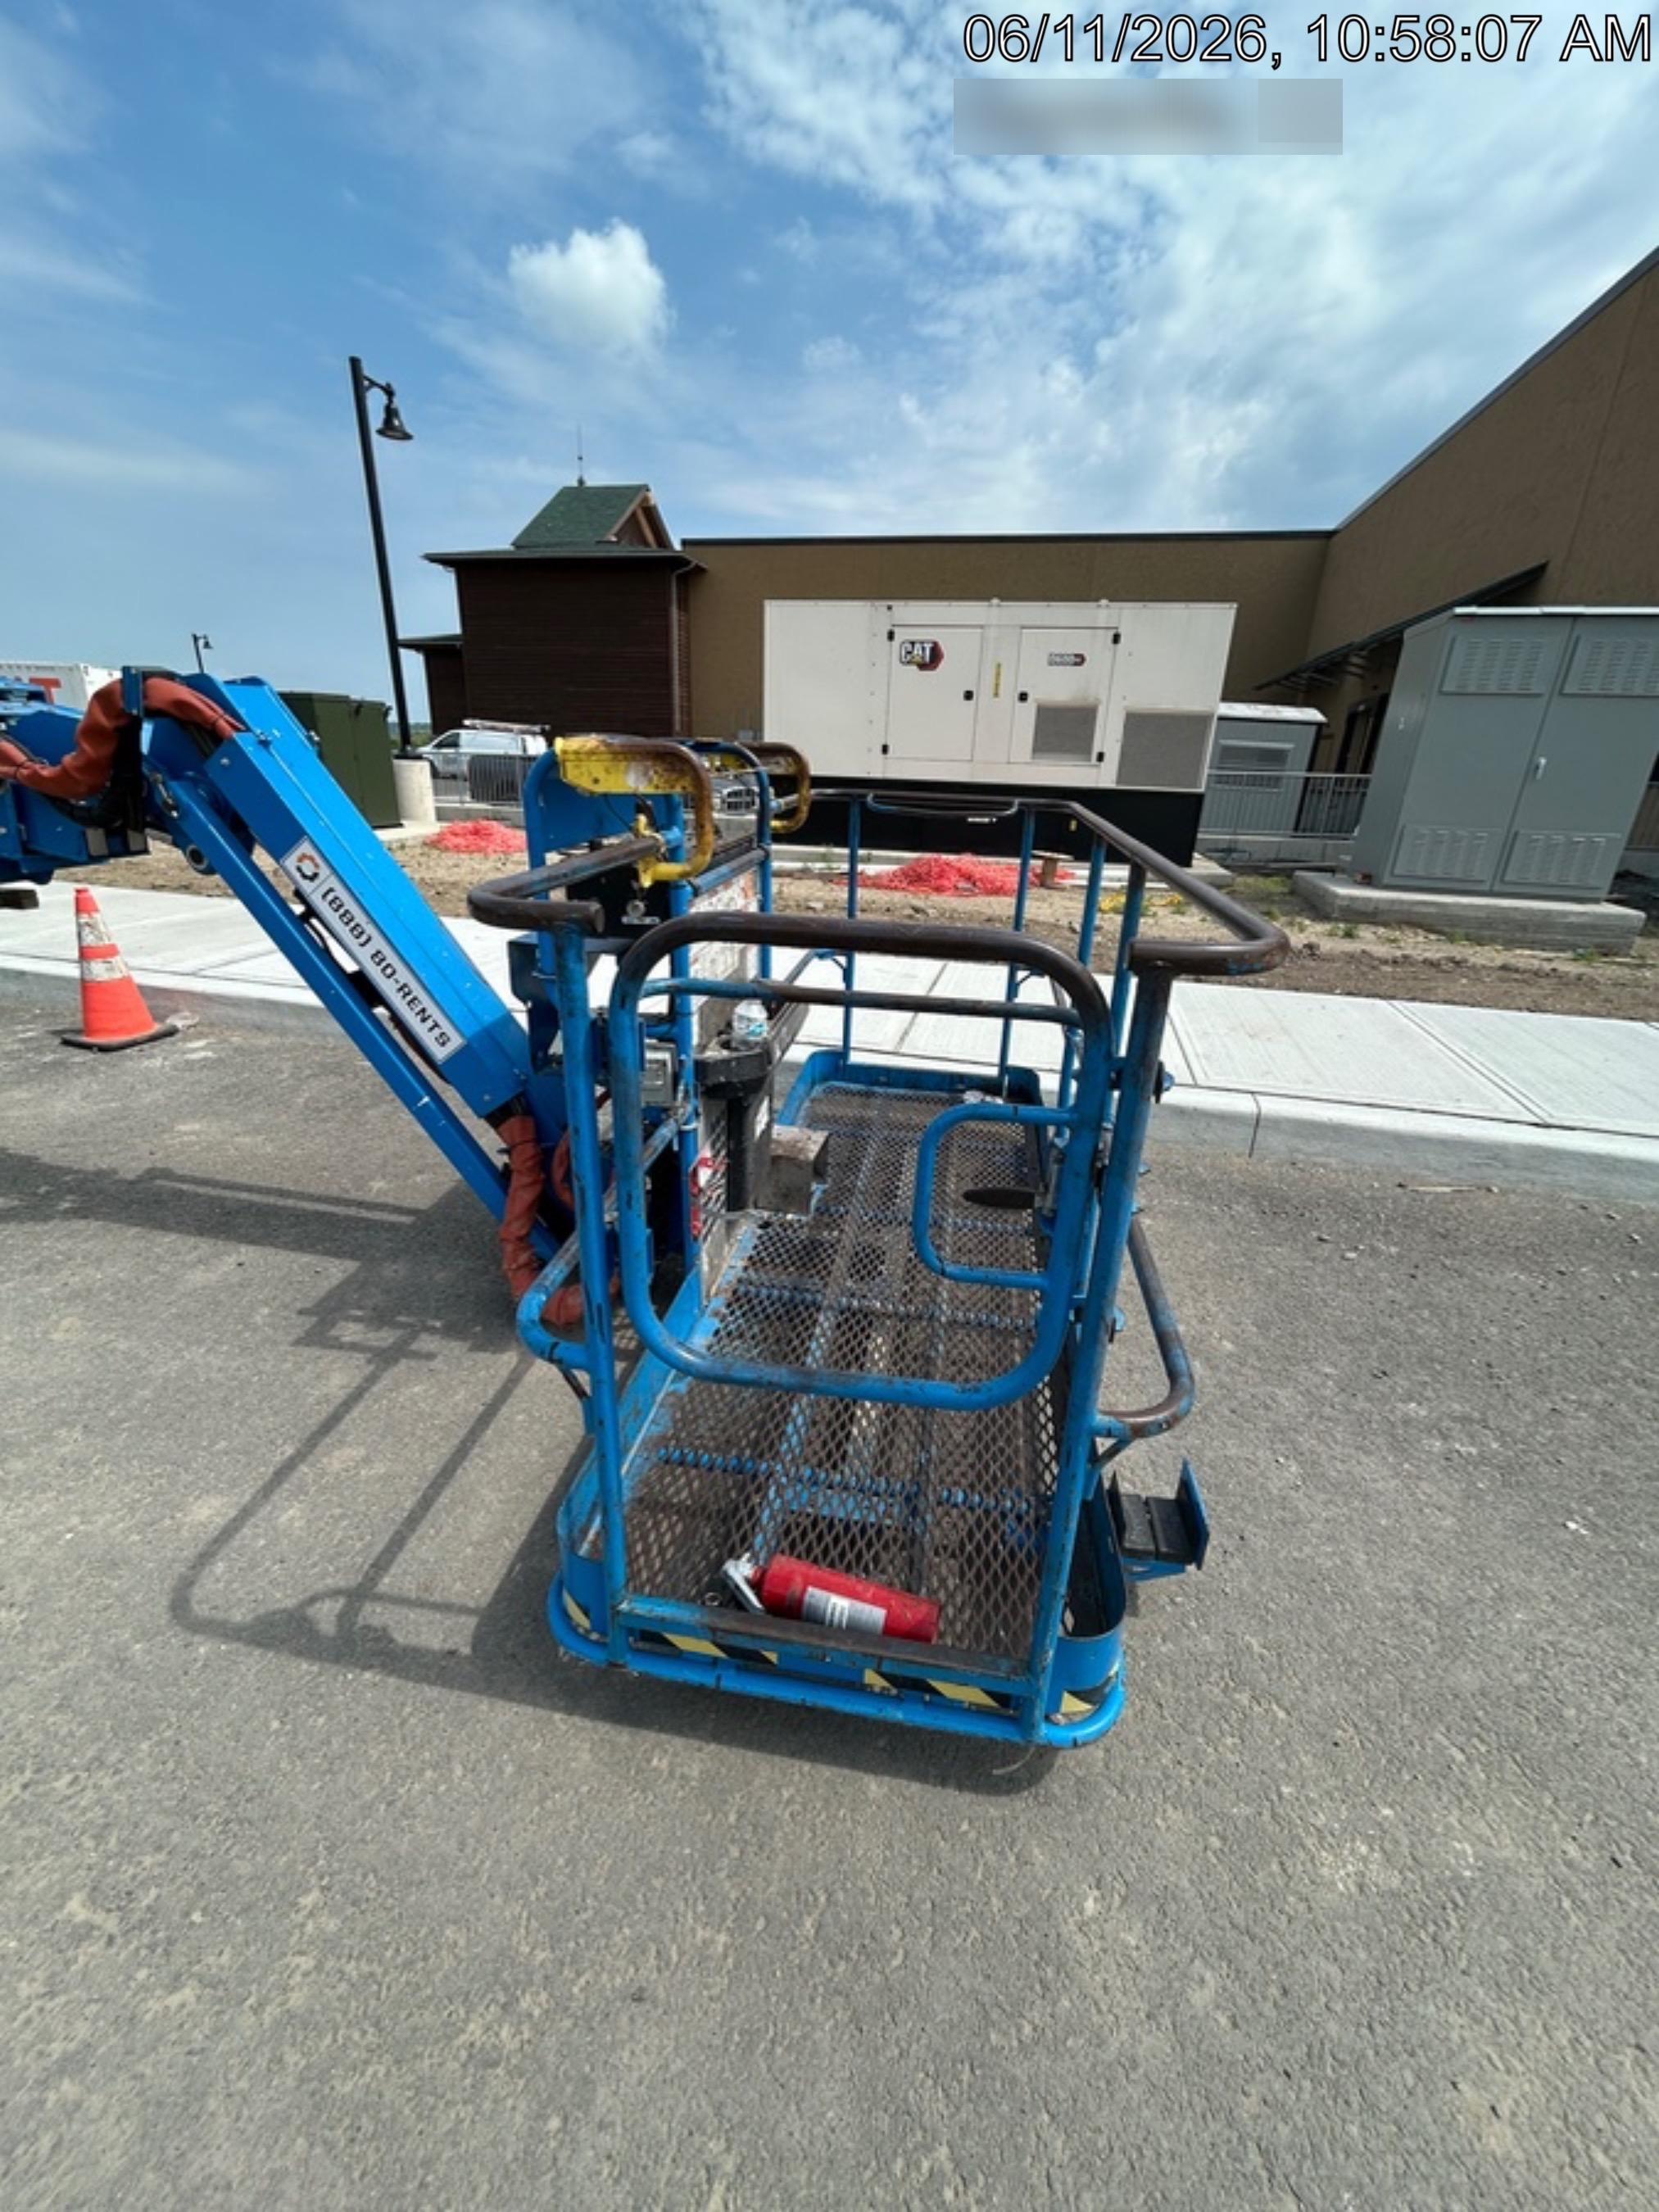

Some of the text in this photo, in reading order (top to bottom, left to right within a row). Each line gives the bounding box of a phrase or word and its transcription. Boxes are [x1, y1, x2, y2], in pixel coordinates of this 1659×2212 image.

[900, 641, 936, 664] CAT
[321, 886, 451, 1047] (888) 80-RENTS
